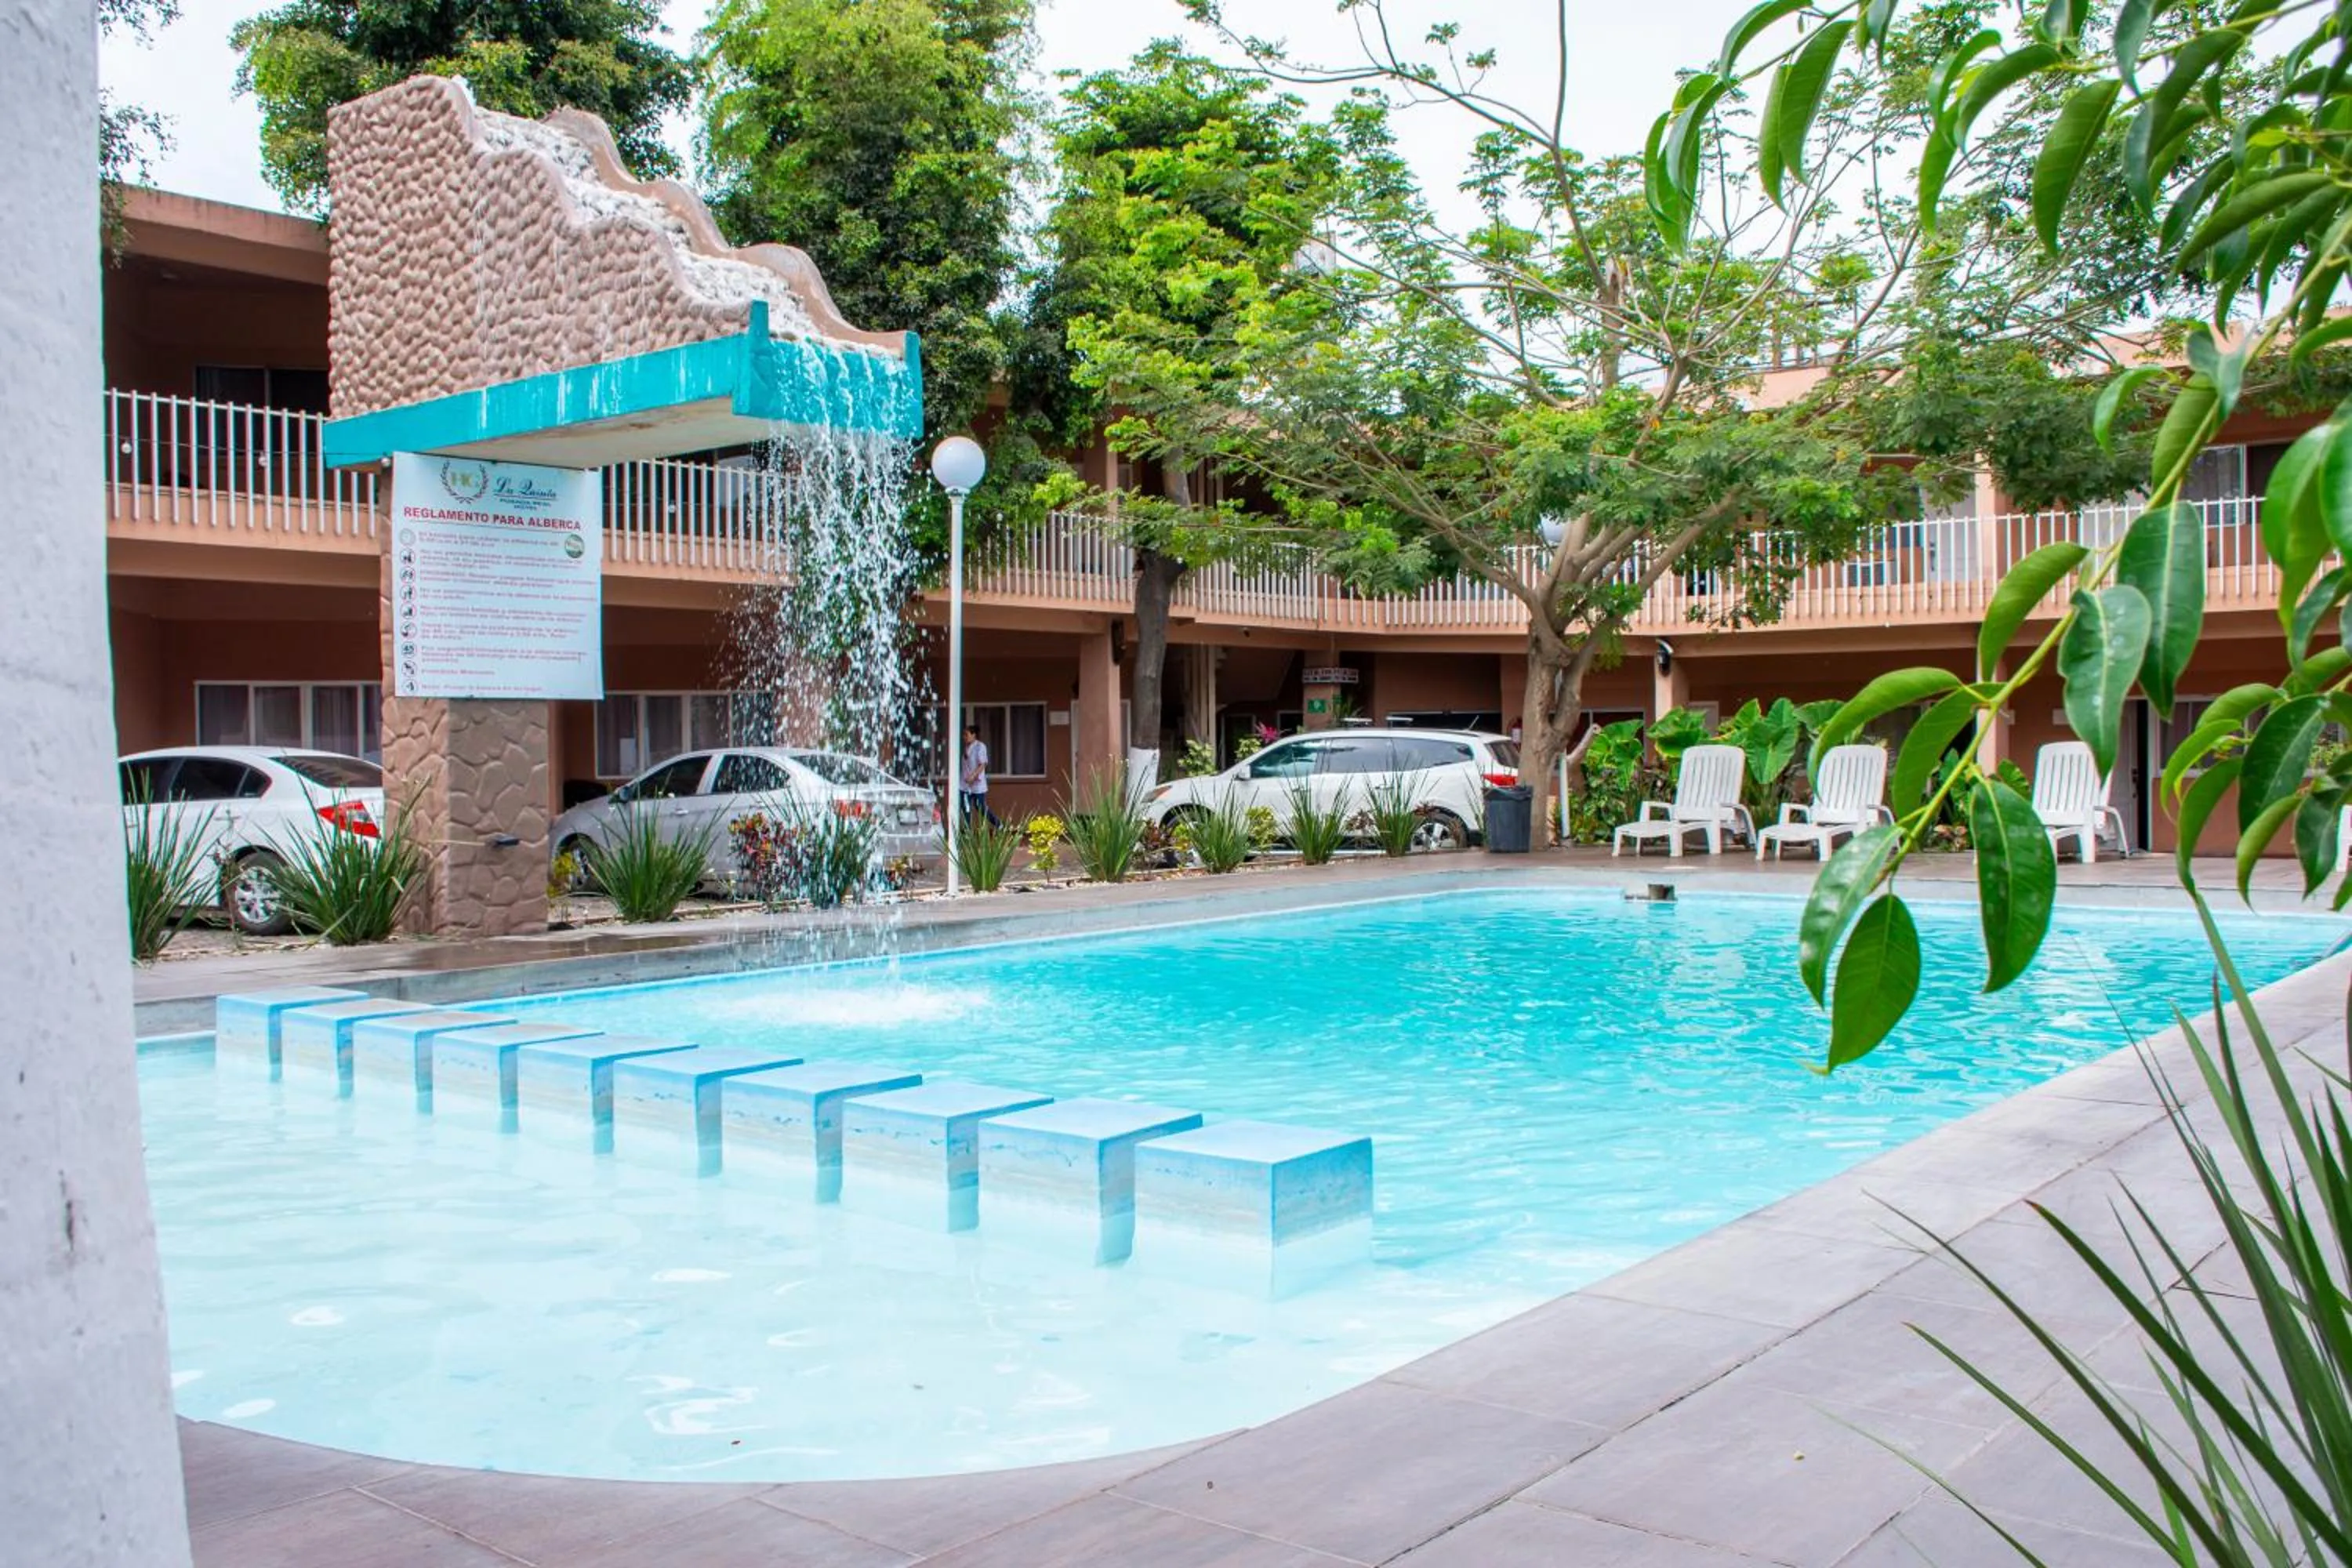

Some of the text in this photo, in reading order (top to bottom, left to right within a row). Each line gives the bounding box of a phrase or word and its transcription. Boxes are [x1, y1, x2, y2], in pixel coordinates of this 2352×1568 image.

[404, 506, 582, 530] REGLAMENTO PARA ALBERCA
